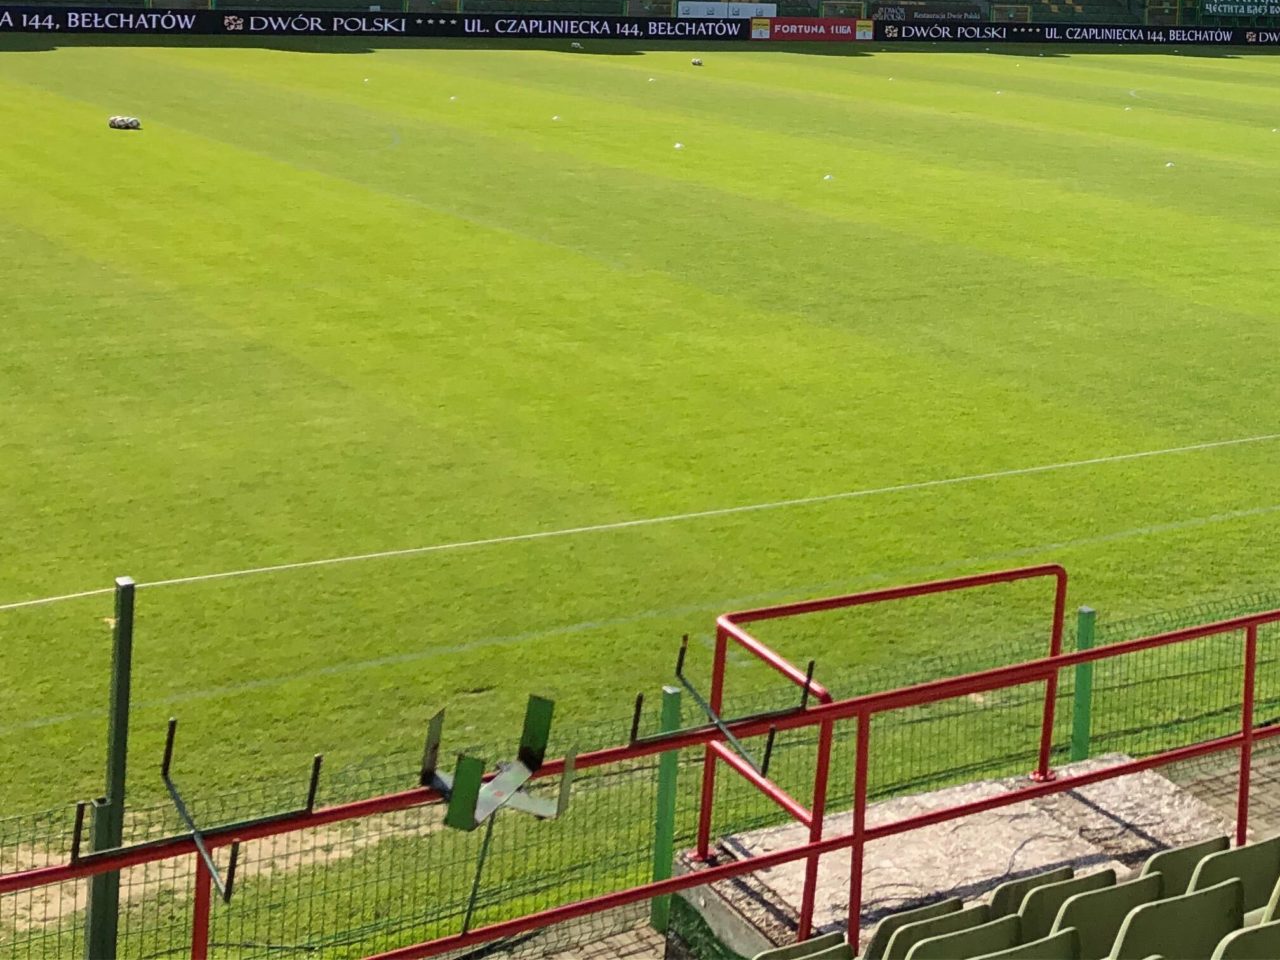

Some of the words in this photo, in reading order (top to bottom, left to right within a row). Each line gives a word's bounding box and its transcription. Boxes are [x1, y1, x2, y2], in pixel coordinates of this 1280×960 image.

[21, 13, 61, 30] 144,
[67, 10, 196, 29] BEŁCHATÓW
[250, 14, 326, 32] DWÓR
[333, 17, 407, 33] POLSKI
[464, 19, 490, 34] UL.
[494, 19, 611, 35] CZAPLINIECKA
[615, 23, 644, 38] 144,
[648, 19, 741, 36] BEŁCHATÓW
[774, 24, 826, 35] FORTUNA
[902, 23, 954, 39] DWÓR
[957, 27, 1007, 39] POLSKI
[1045, 27, 1063, 40] UL.
[1065, 27, 1145, 41] CZAPLINIECKA
[1147, 31, 1167, 43] 144,
[1168, 27, 1233, 42] BEŁCHATÓW
